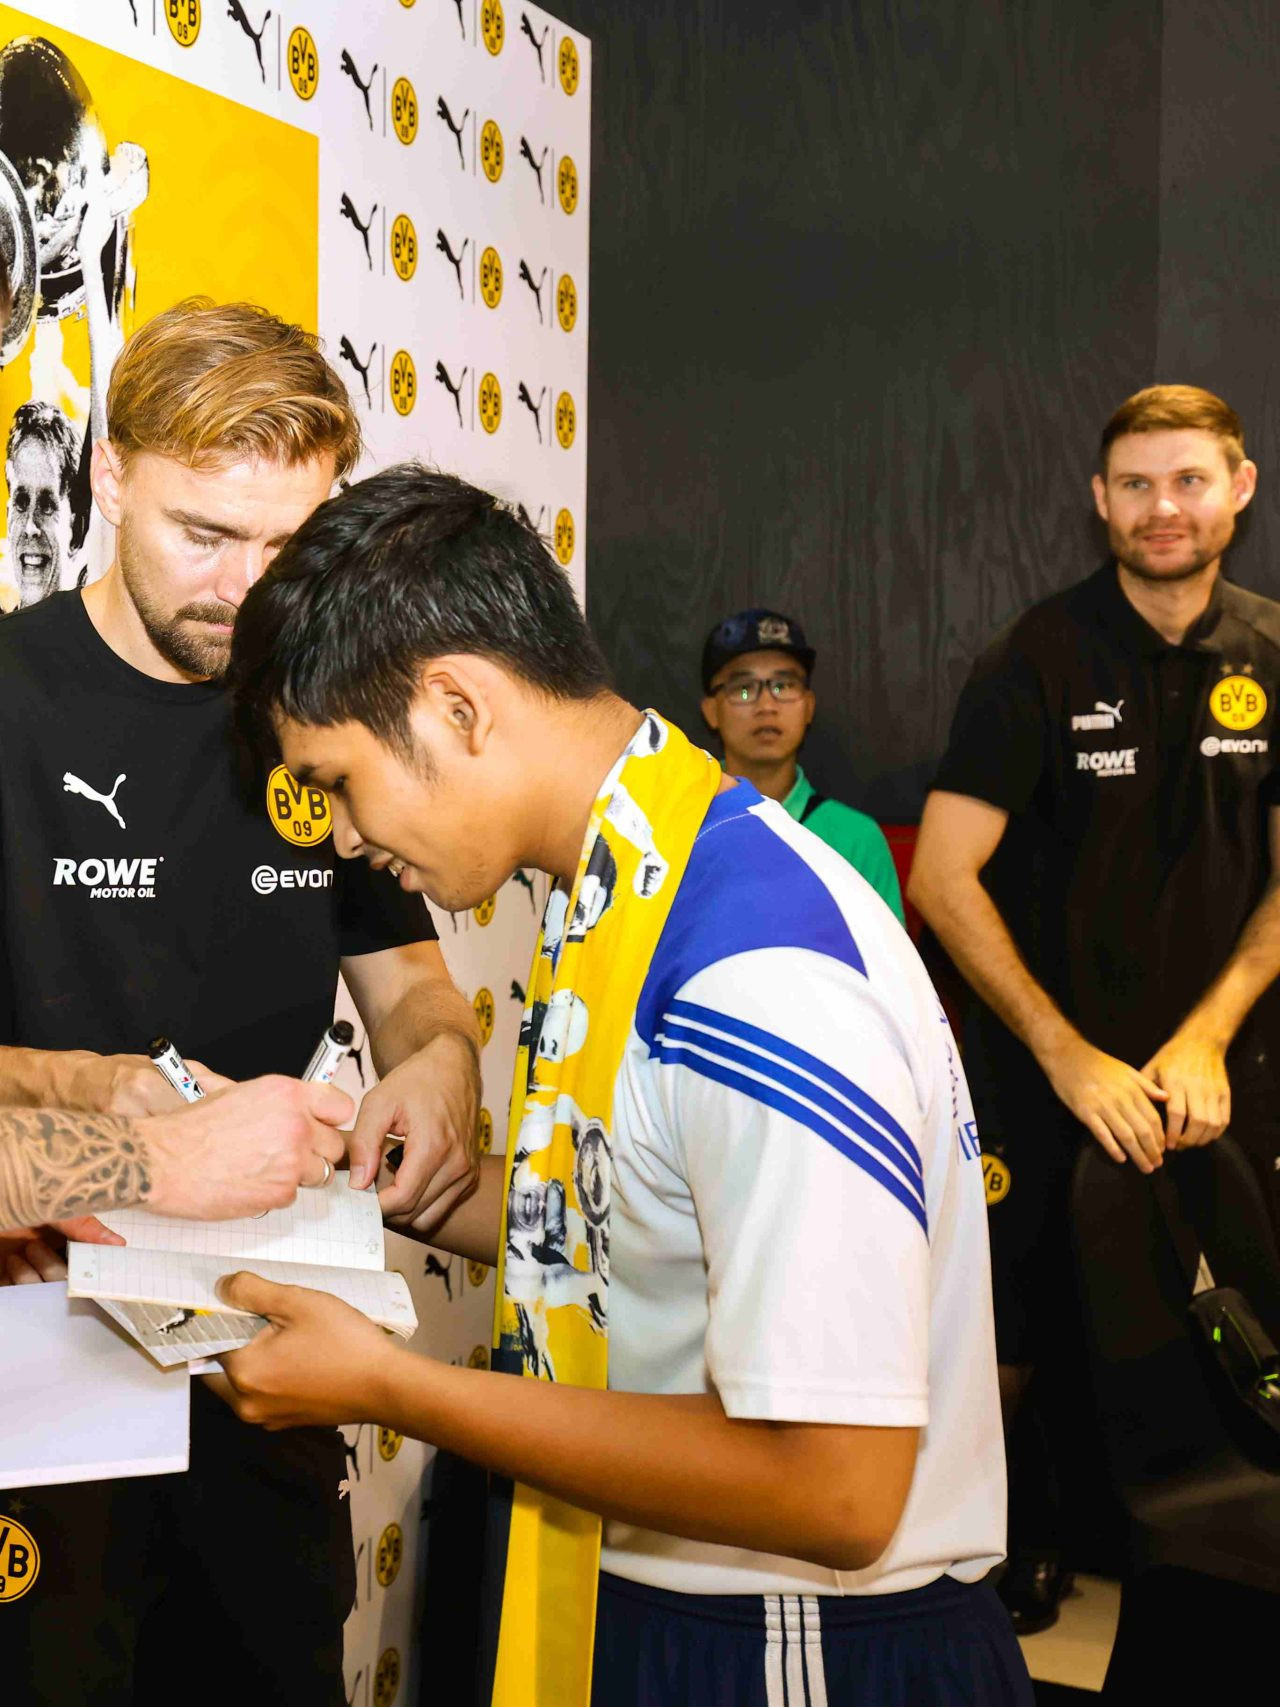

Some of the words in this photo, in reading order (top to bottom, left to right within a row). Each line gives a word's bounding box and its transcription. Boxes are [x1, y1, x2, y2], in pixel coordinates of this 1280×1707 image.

[292, 33, 316, 82] BVB
[1220, 684, 1258, 712] BVB
[1076, 749, 1136, 771] ROWE
[293, 821, 313, 837] 09
[53, 858, 158, 886] ROWE
[90, 887, 136, 899] MOTOR
[137, 887, 156, 898] OIL
